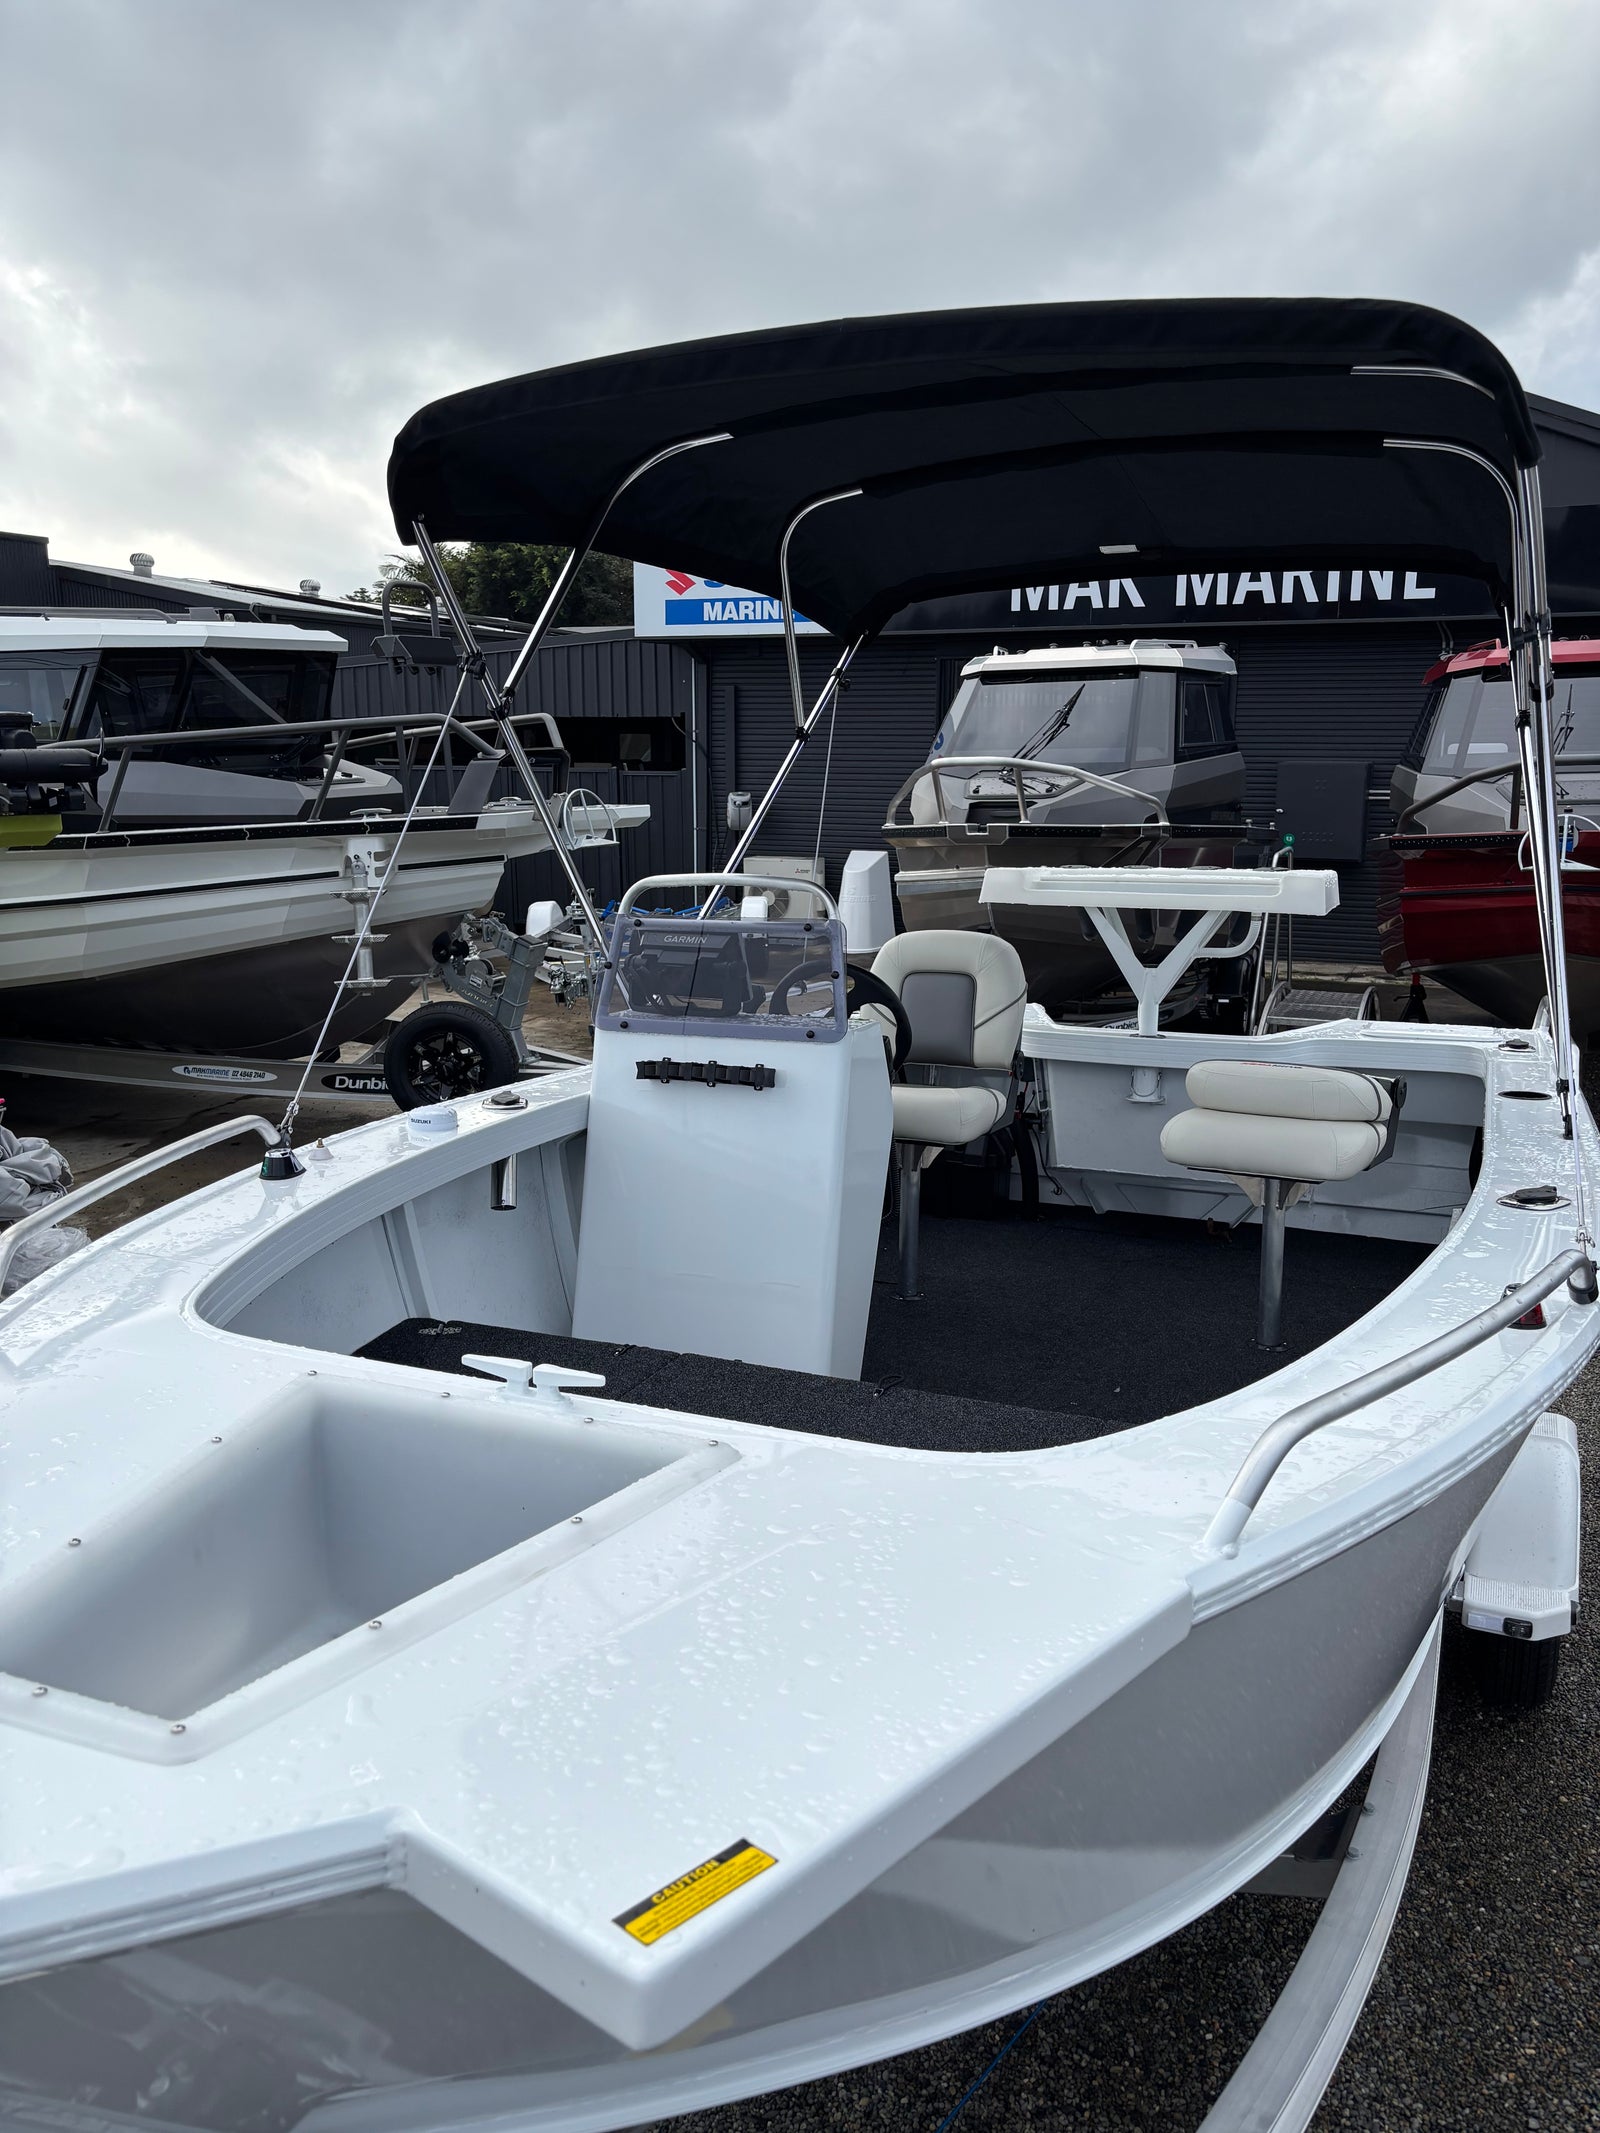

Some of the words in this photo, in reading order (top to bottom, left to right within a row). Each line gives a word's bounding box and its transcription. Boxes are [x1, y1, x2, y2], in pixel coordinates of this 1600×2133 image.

[663, 935, 708, 944] GARMIN
[410, 1117, 432, 1125] SUZUKI
[651, 1859, 721, 1905] CAUTION
